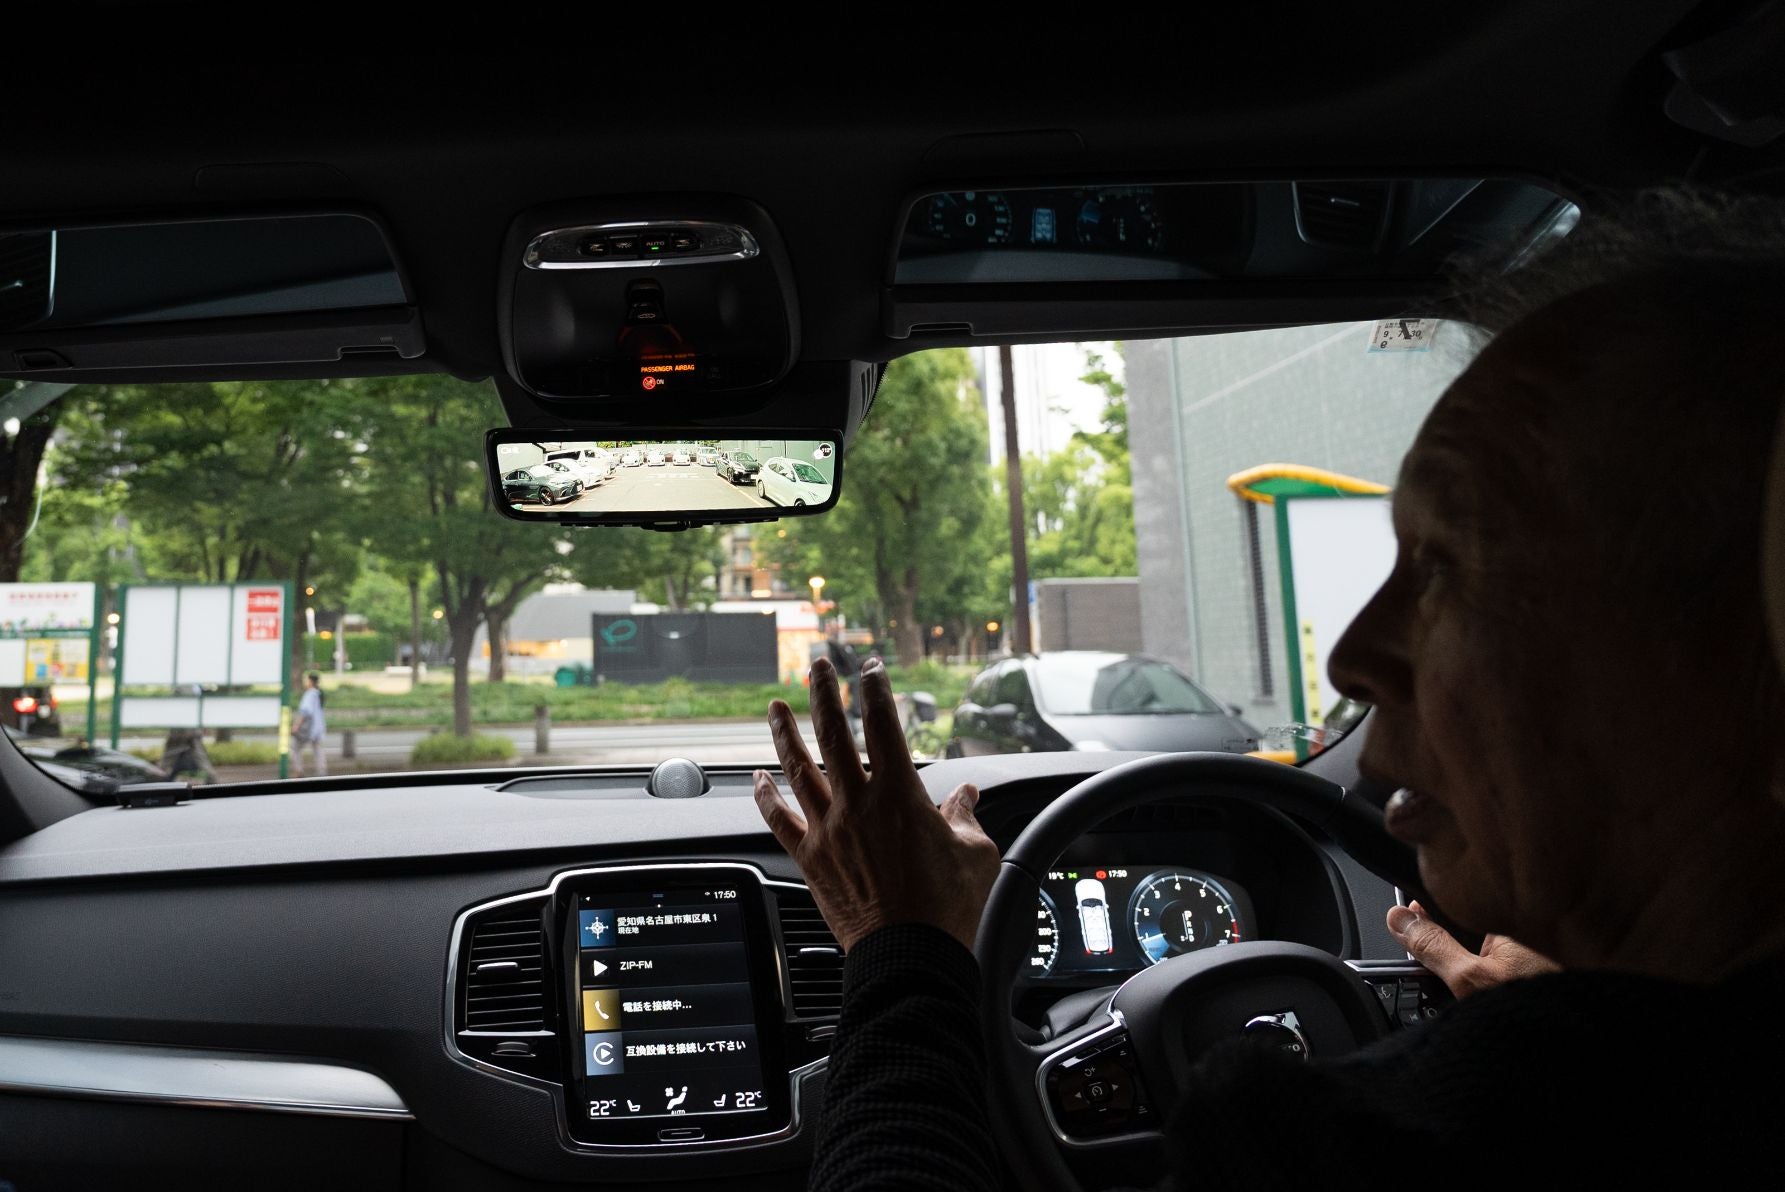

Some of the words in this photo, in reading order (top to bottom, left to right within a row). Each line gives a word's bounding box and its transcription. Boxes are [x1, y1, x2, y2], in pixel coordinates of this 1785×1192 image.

[640, 365, 673, 373] PASSENGER
[1108, 870, 1128, 878] 17:50
[714, 890, 737, 899] 17:50
[1200, 889, 1206, 897] 5
[1144, 908, 1150, 916] 2
[618, 926, 640, 934] 現在地
[1225, 929, 1230, 937] 7
[619, 960, 653, 971] ZIP-FM
[626, 1040, 746, 1057] 互換設備を接続して下さい
